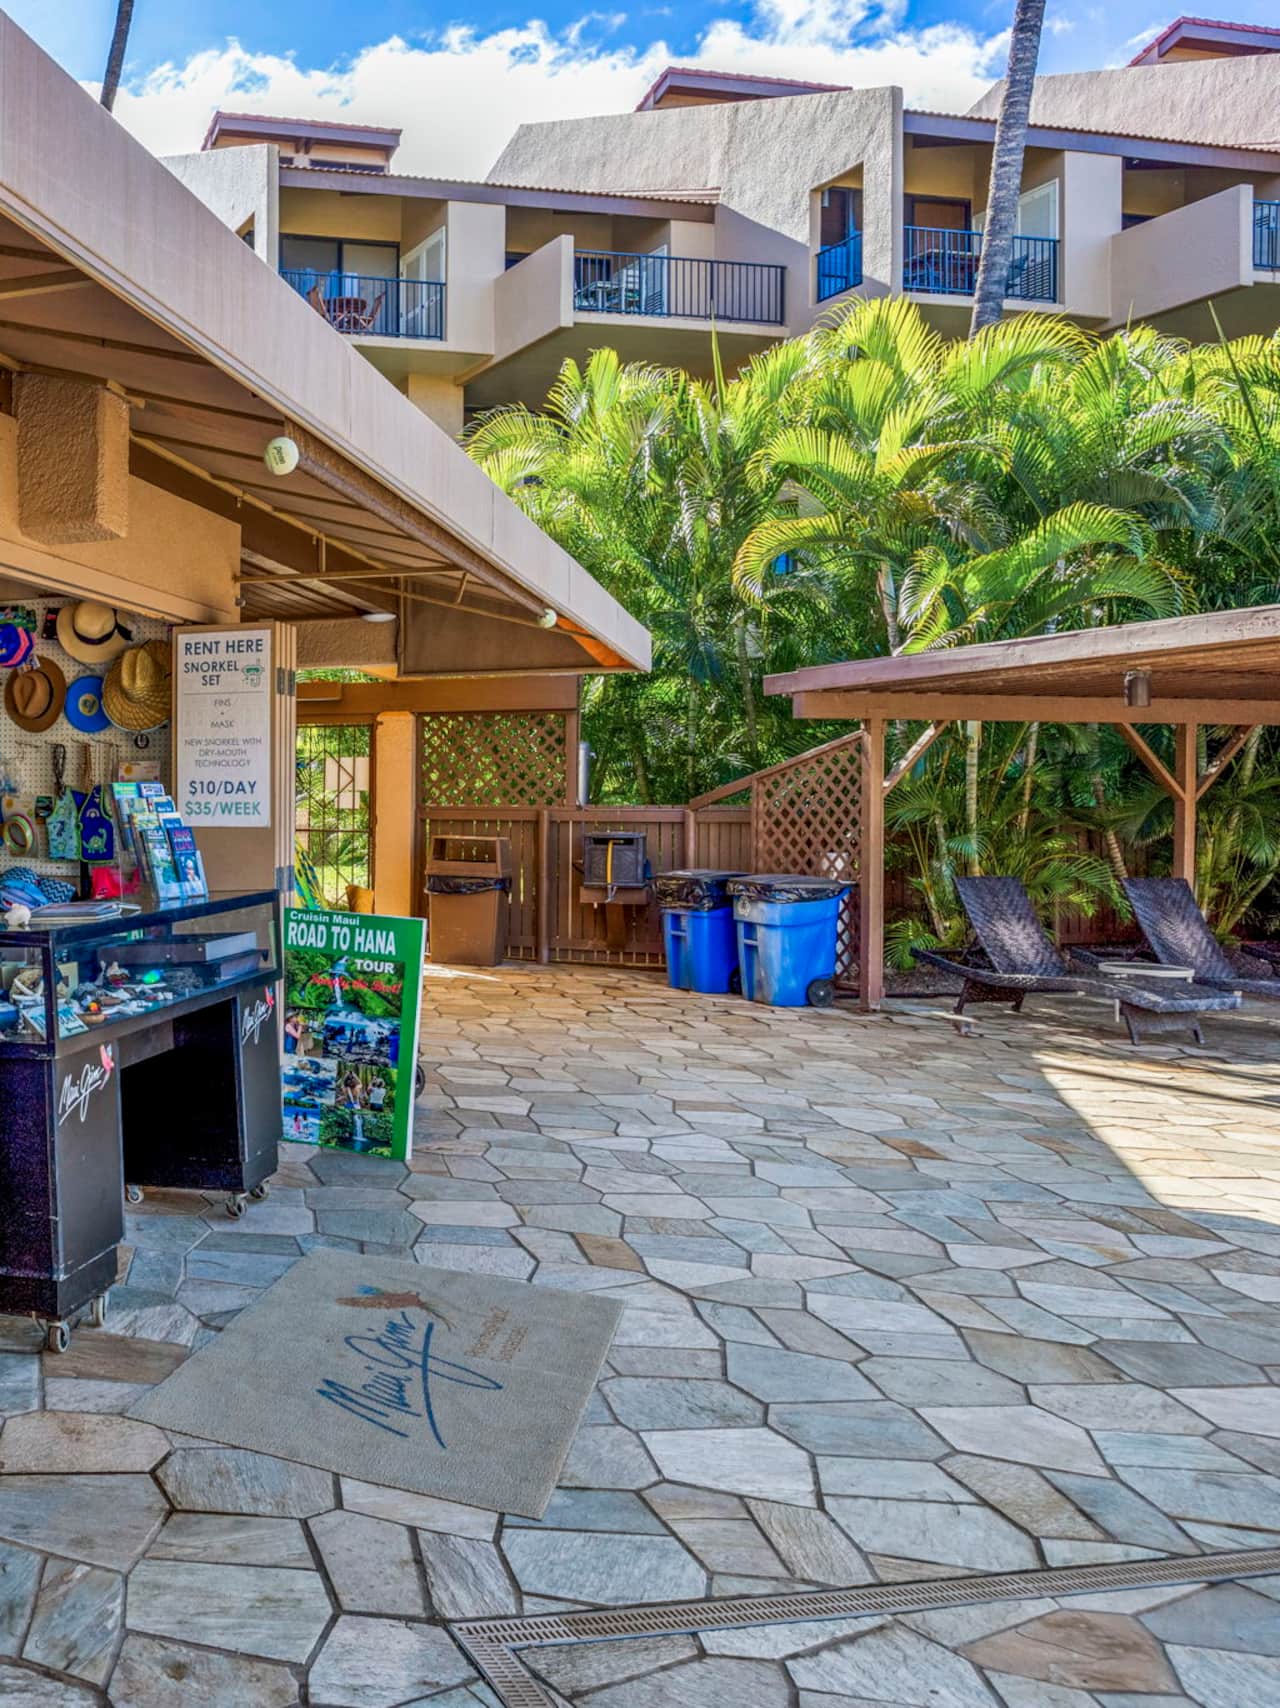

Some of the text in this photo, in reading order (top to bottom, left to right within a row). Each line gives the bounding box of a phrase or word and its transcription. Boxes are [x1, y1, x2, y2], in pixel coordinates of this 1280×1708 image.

[184, 639, 264, 655] RENT HERE
[183, 661, 239, 673] SNORKEL
[201, 675, 220, 686] SET
[214, 698, 231, 707] FINS
[210, 720, 235, 729] MASK
[184, 737, 262, 746] NEW SNORKEL WITH
[195, 759, 251, 769] TECHNOLOGY
[189, 780, 257, 796] $10/DAY
[185, 801, 261, 816] $35/WEEK
[290, 910, 360, 925] Cruisin Maui
[288, 921, 396, 956] ROAD TO HANA
[355, 959, 395, 974] TOUR
[343, 1310, 504, 1391] Jim
[316, 1364, 422, 1438] Maui
